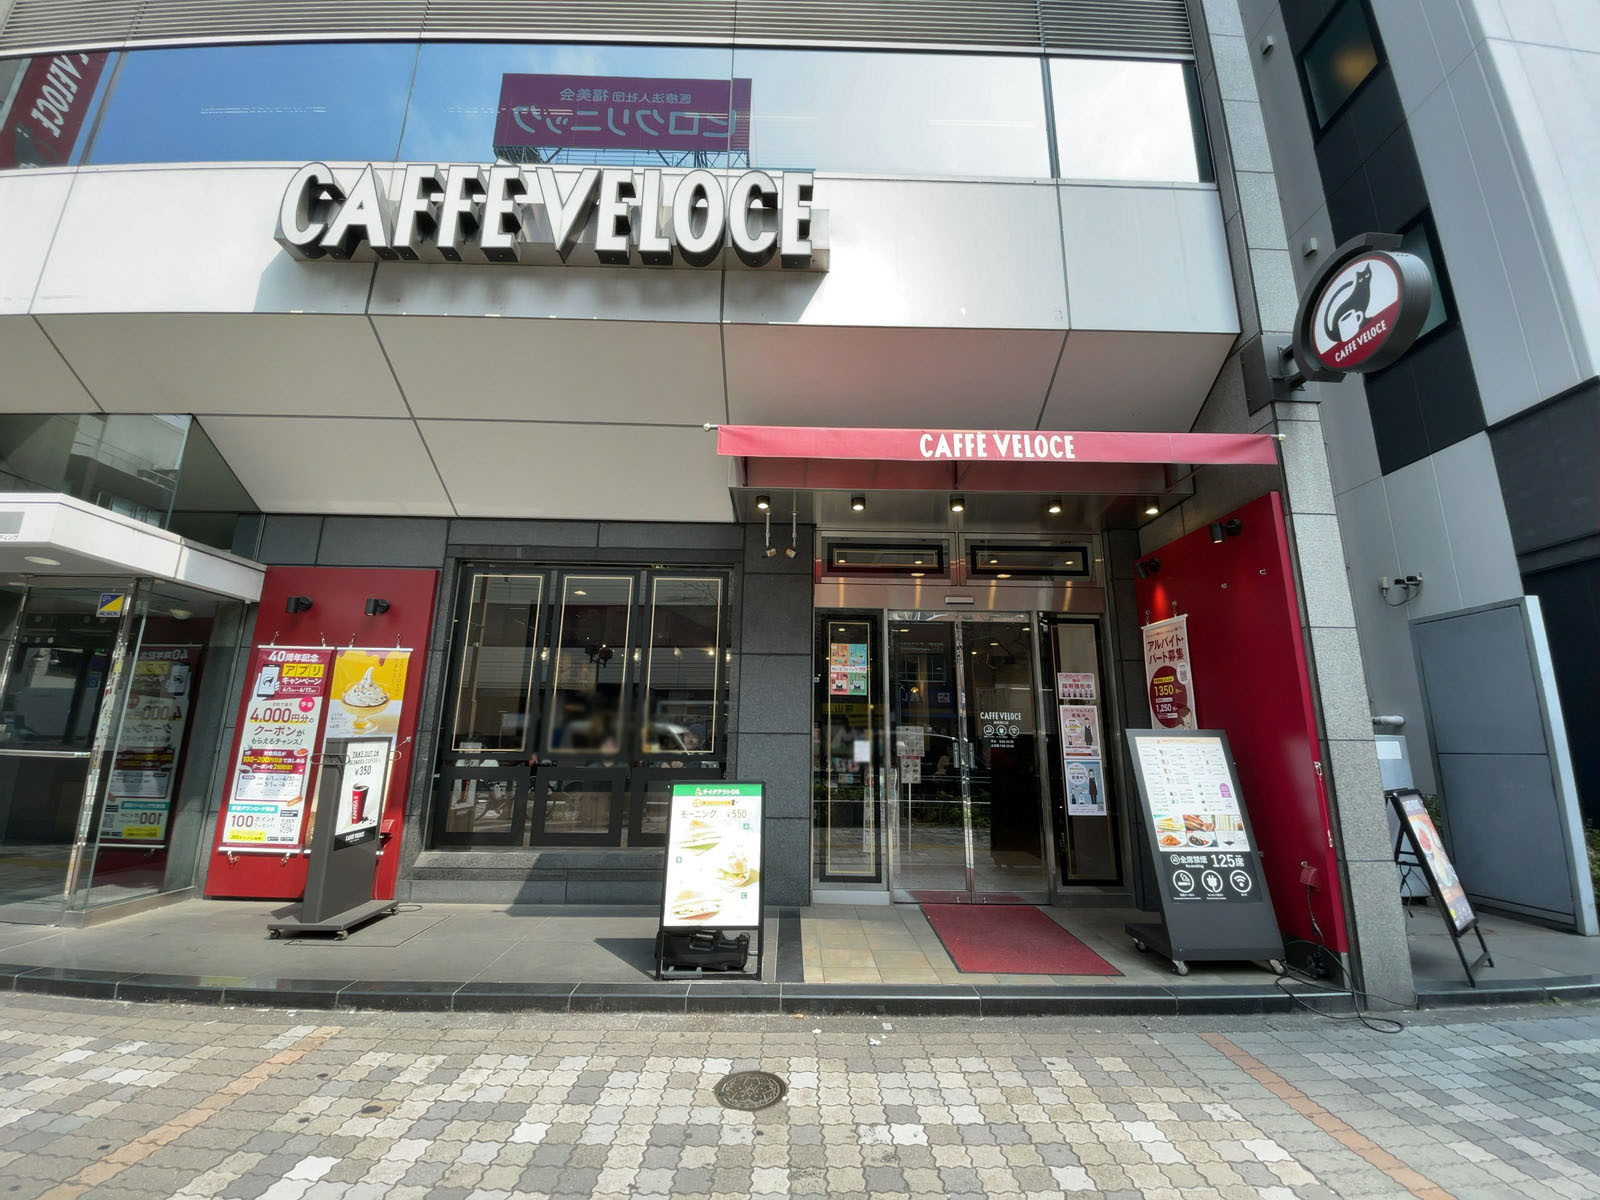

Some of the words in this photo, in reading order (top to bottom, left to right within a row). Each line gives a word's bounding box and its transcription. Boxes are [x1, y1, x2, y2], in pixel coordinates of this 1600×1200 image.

[536, 165, 815, 257] VELOCE
[1356, 320, 1387, 346] VELOCE
[992, 434, 1076, 459] VELOCE
[268, 650, 319, 663] 40周年記念
[1149, 648, 1185, 664] パート募集
[283, 664, 323, 676] アプリ
[282, 677, 322, 686] キャンペーン
[250, 707, 315, 724] 4,000円分の
[999, 712, 1022, 721] VELOCE
[254, 725, 305, 737] クーポンが
[680, 809, 717, 819] モーニング
